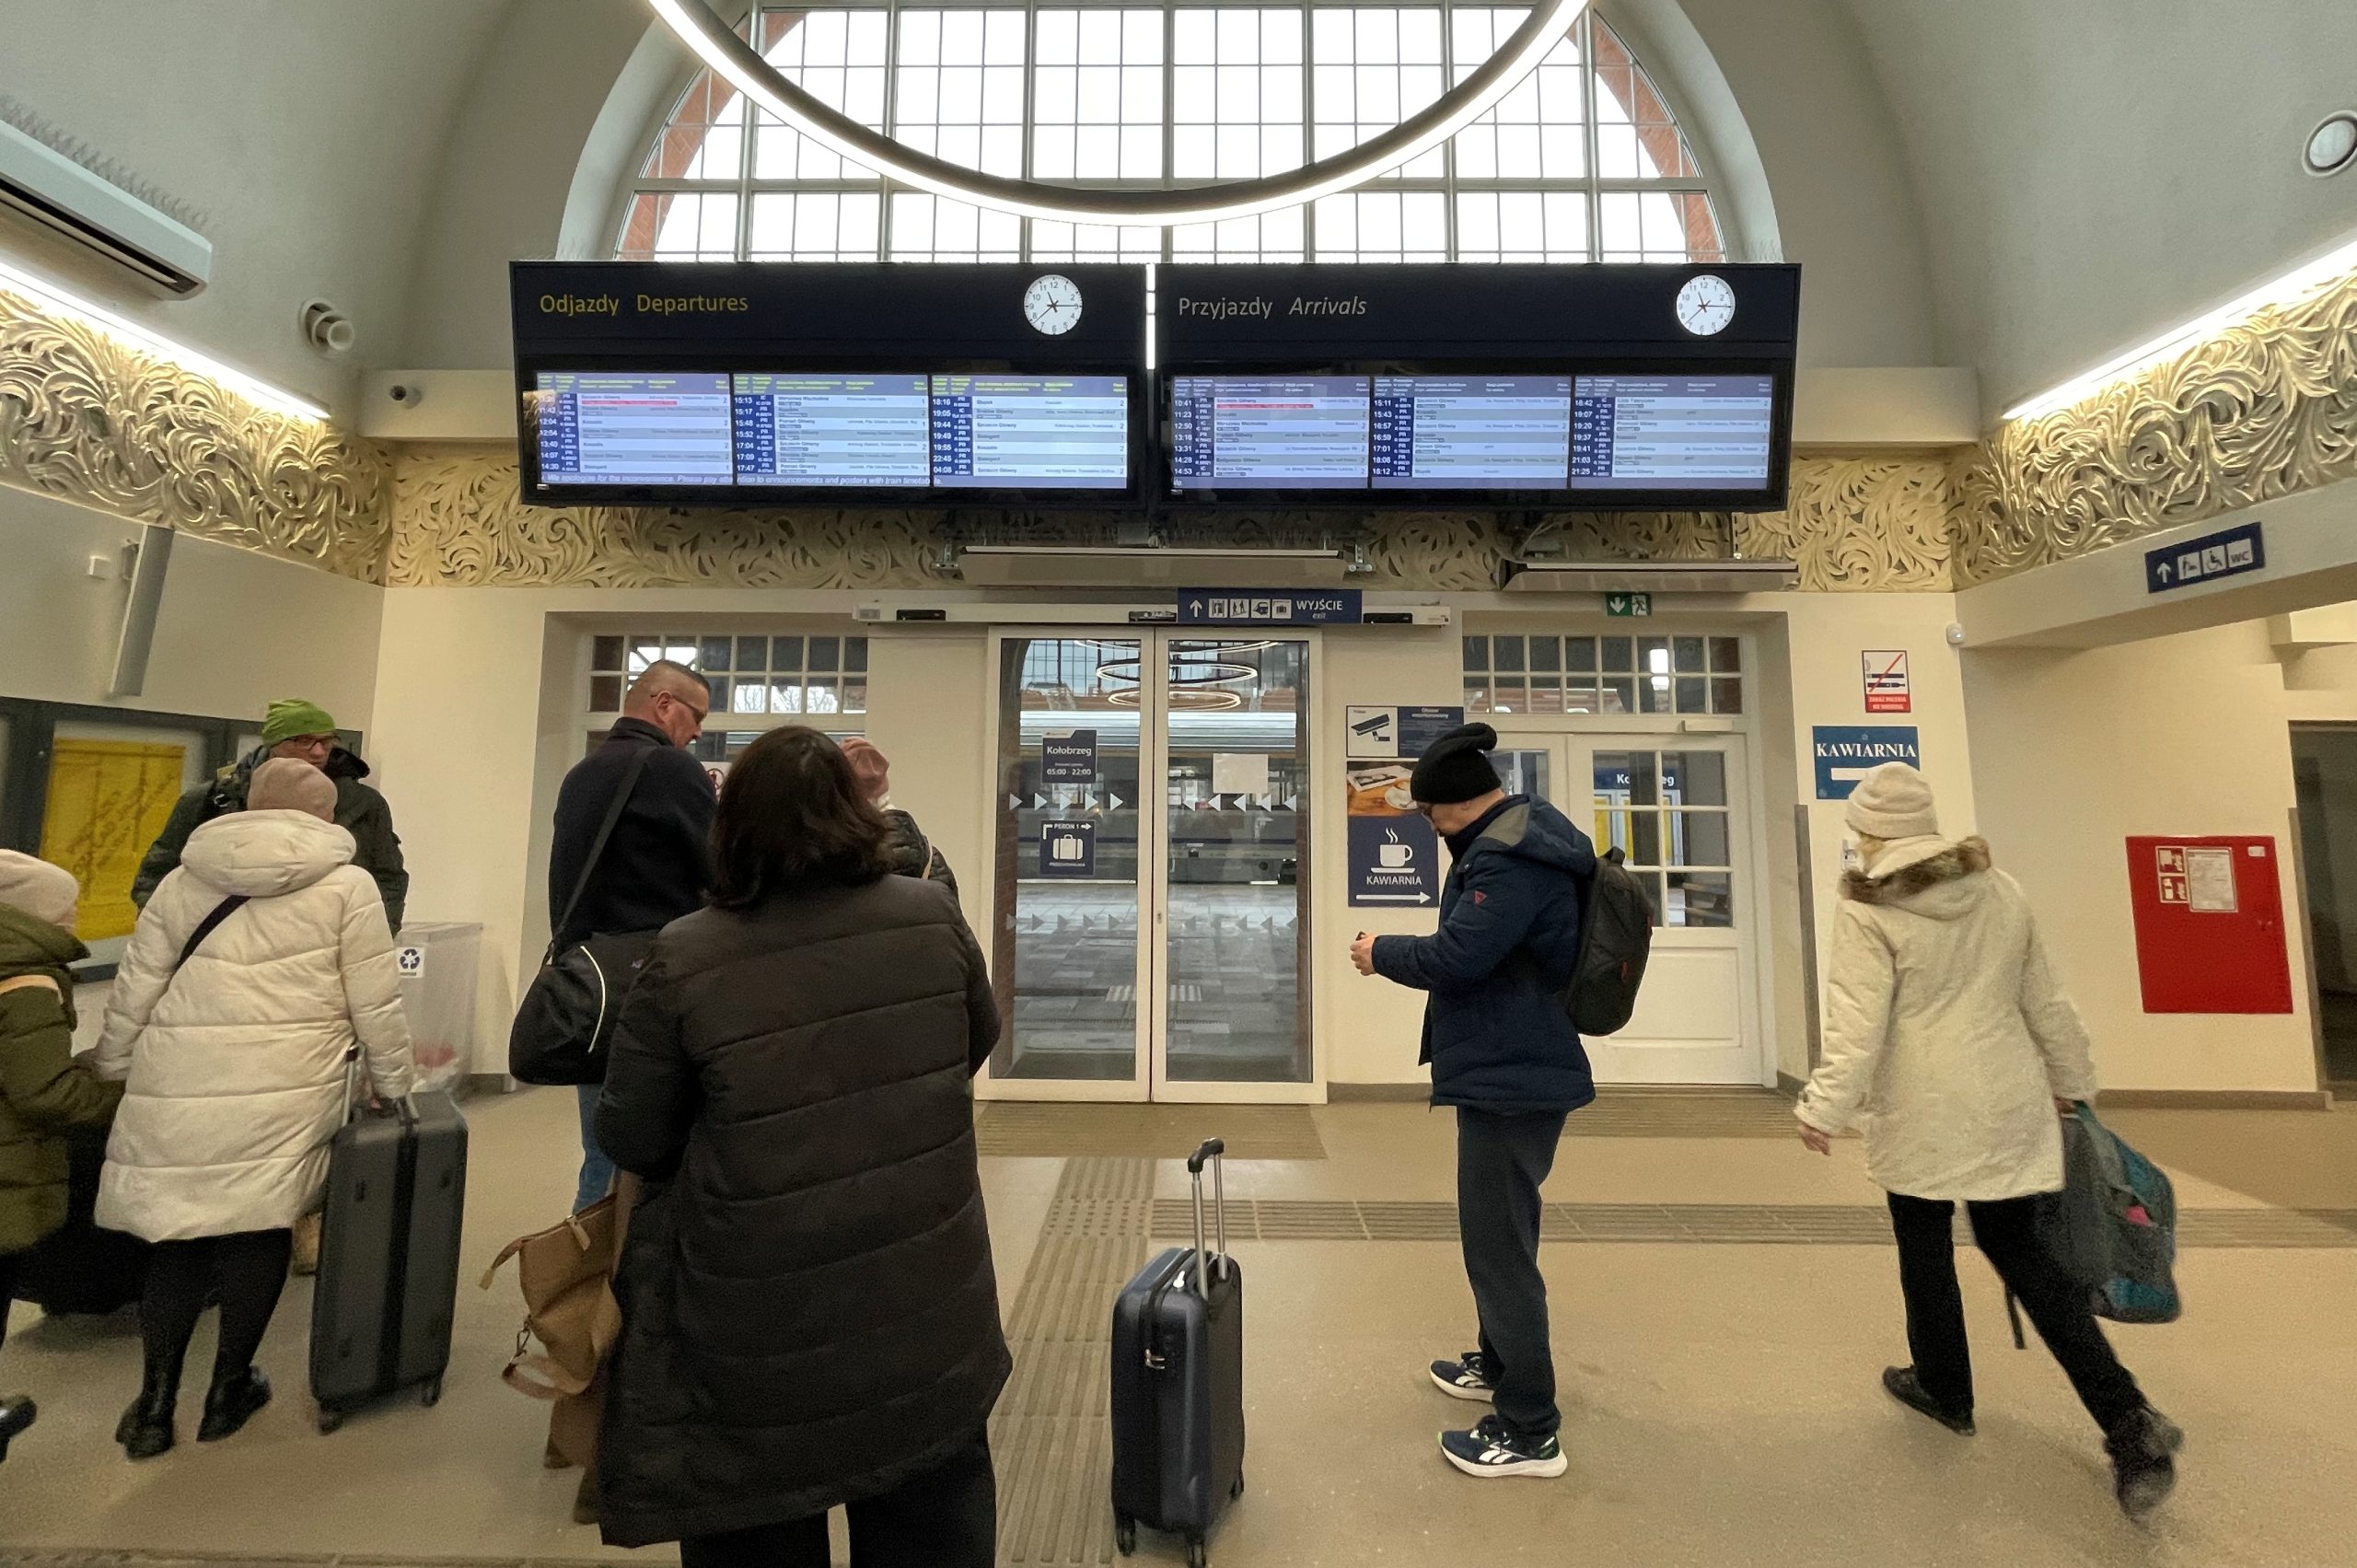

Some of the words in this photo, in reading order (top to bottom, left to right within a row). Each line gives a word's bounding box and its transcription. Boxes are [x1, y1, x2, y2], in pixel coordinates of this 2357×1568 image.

[540, 295, 620, 317] Odjazdy
[637, 294, 749, 316] Departures
[1178, 296, 1272, 319] Przyjazdy
[1289, 296, 1367, 316] Arrivals
[933, 466, 952, 474] 04:08
[548, 474, 560, 482] We
[598, 474, 607, 482] for
[609, 474, 621, 482] the
[703, 476, 717, 485] pay
[825, 476, 839, 484] and
[841, 477, 867, 486] posters
[869, 476, 884, 484] with
[885, 476, 902, 484] train
[2230, 551, 2249, 563] WC
[1296, 598, 1343, 610] WYJŚCIE
[1047, 746, 1092, 757] Kołobrzeg
[1817, 743, 1916, 757] KAWIARNIA
[1366, 876, 1422, 885] KAWIARNIA
